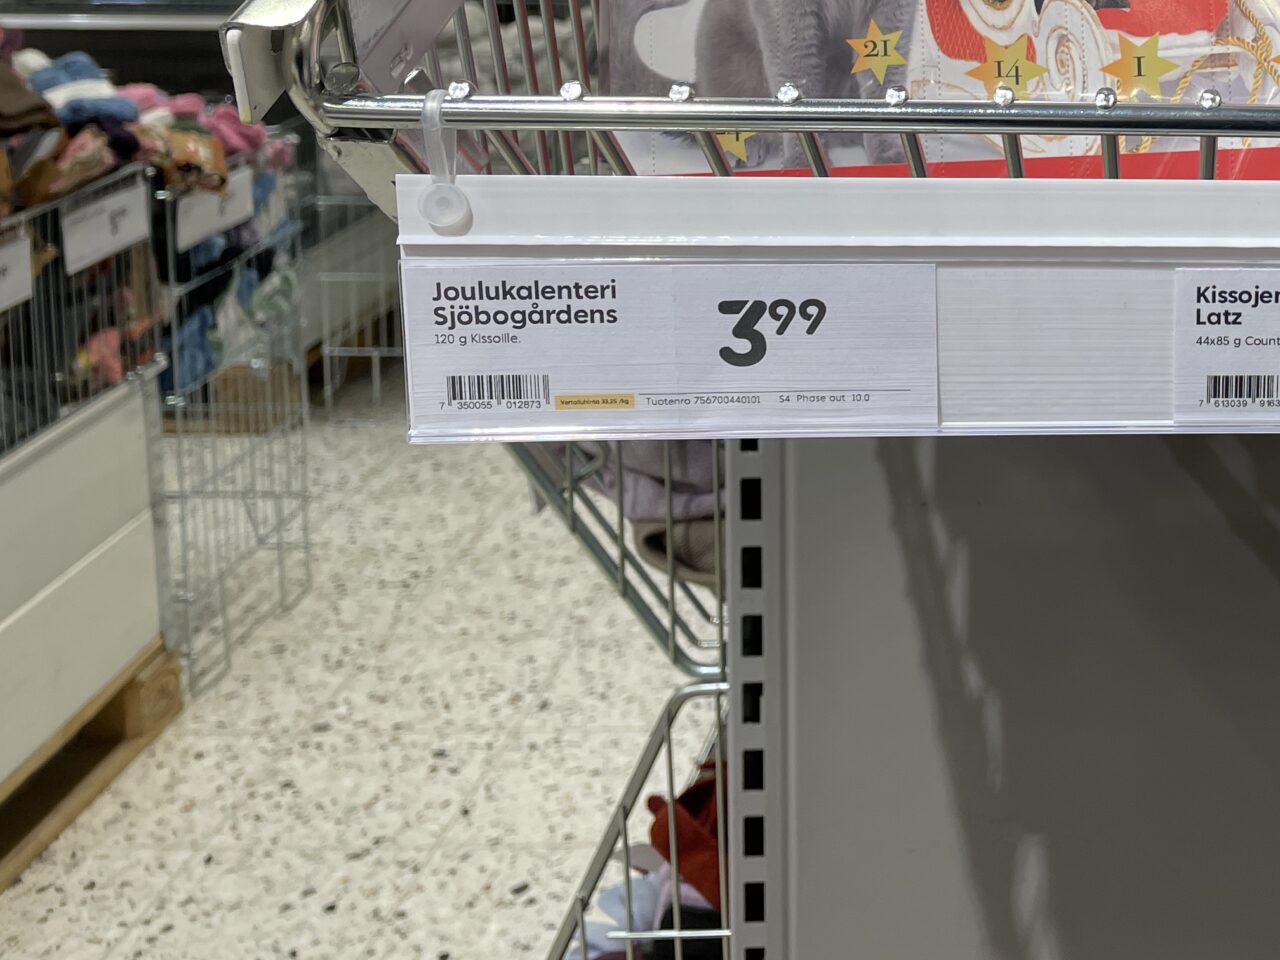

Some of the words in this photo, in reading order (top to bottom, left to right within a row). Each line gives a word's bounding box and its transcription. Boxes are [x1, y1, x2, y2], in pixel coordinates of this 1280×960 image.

[863, 39, 891, 58] 21
[993, 59, 1022, 86] 14
[432, 279, 617, 302] Joulukalenteri
[433, 302, 618, 330] Sjöbogårdens
[1196, 308, 1243, 326] Latz
[435, 333, 455, 345] 120
[459, 336, 467, 347] g
[470, 332, 521, 344] Kissoille.
[1195, 336, 1230, 346] 44x85
[1233, 338, 1241, 348] g
[440, 402, 446, 410] 7
[457, 400, 493, 410] 350055
[506, 400, 542, 409] 012873
[646, 397, 691, 406] Tuotenro
[693, 395, 761, 405] 756700440101
[797, 394, 827, 403] Phase
[829, 394, 846, 402] out
[1198, 399, 1204, 407] 7
[1214, 399, 1248, 407] 613039
